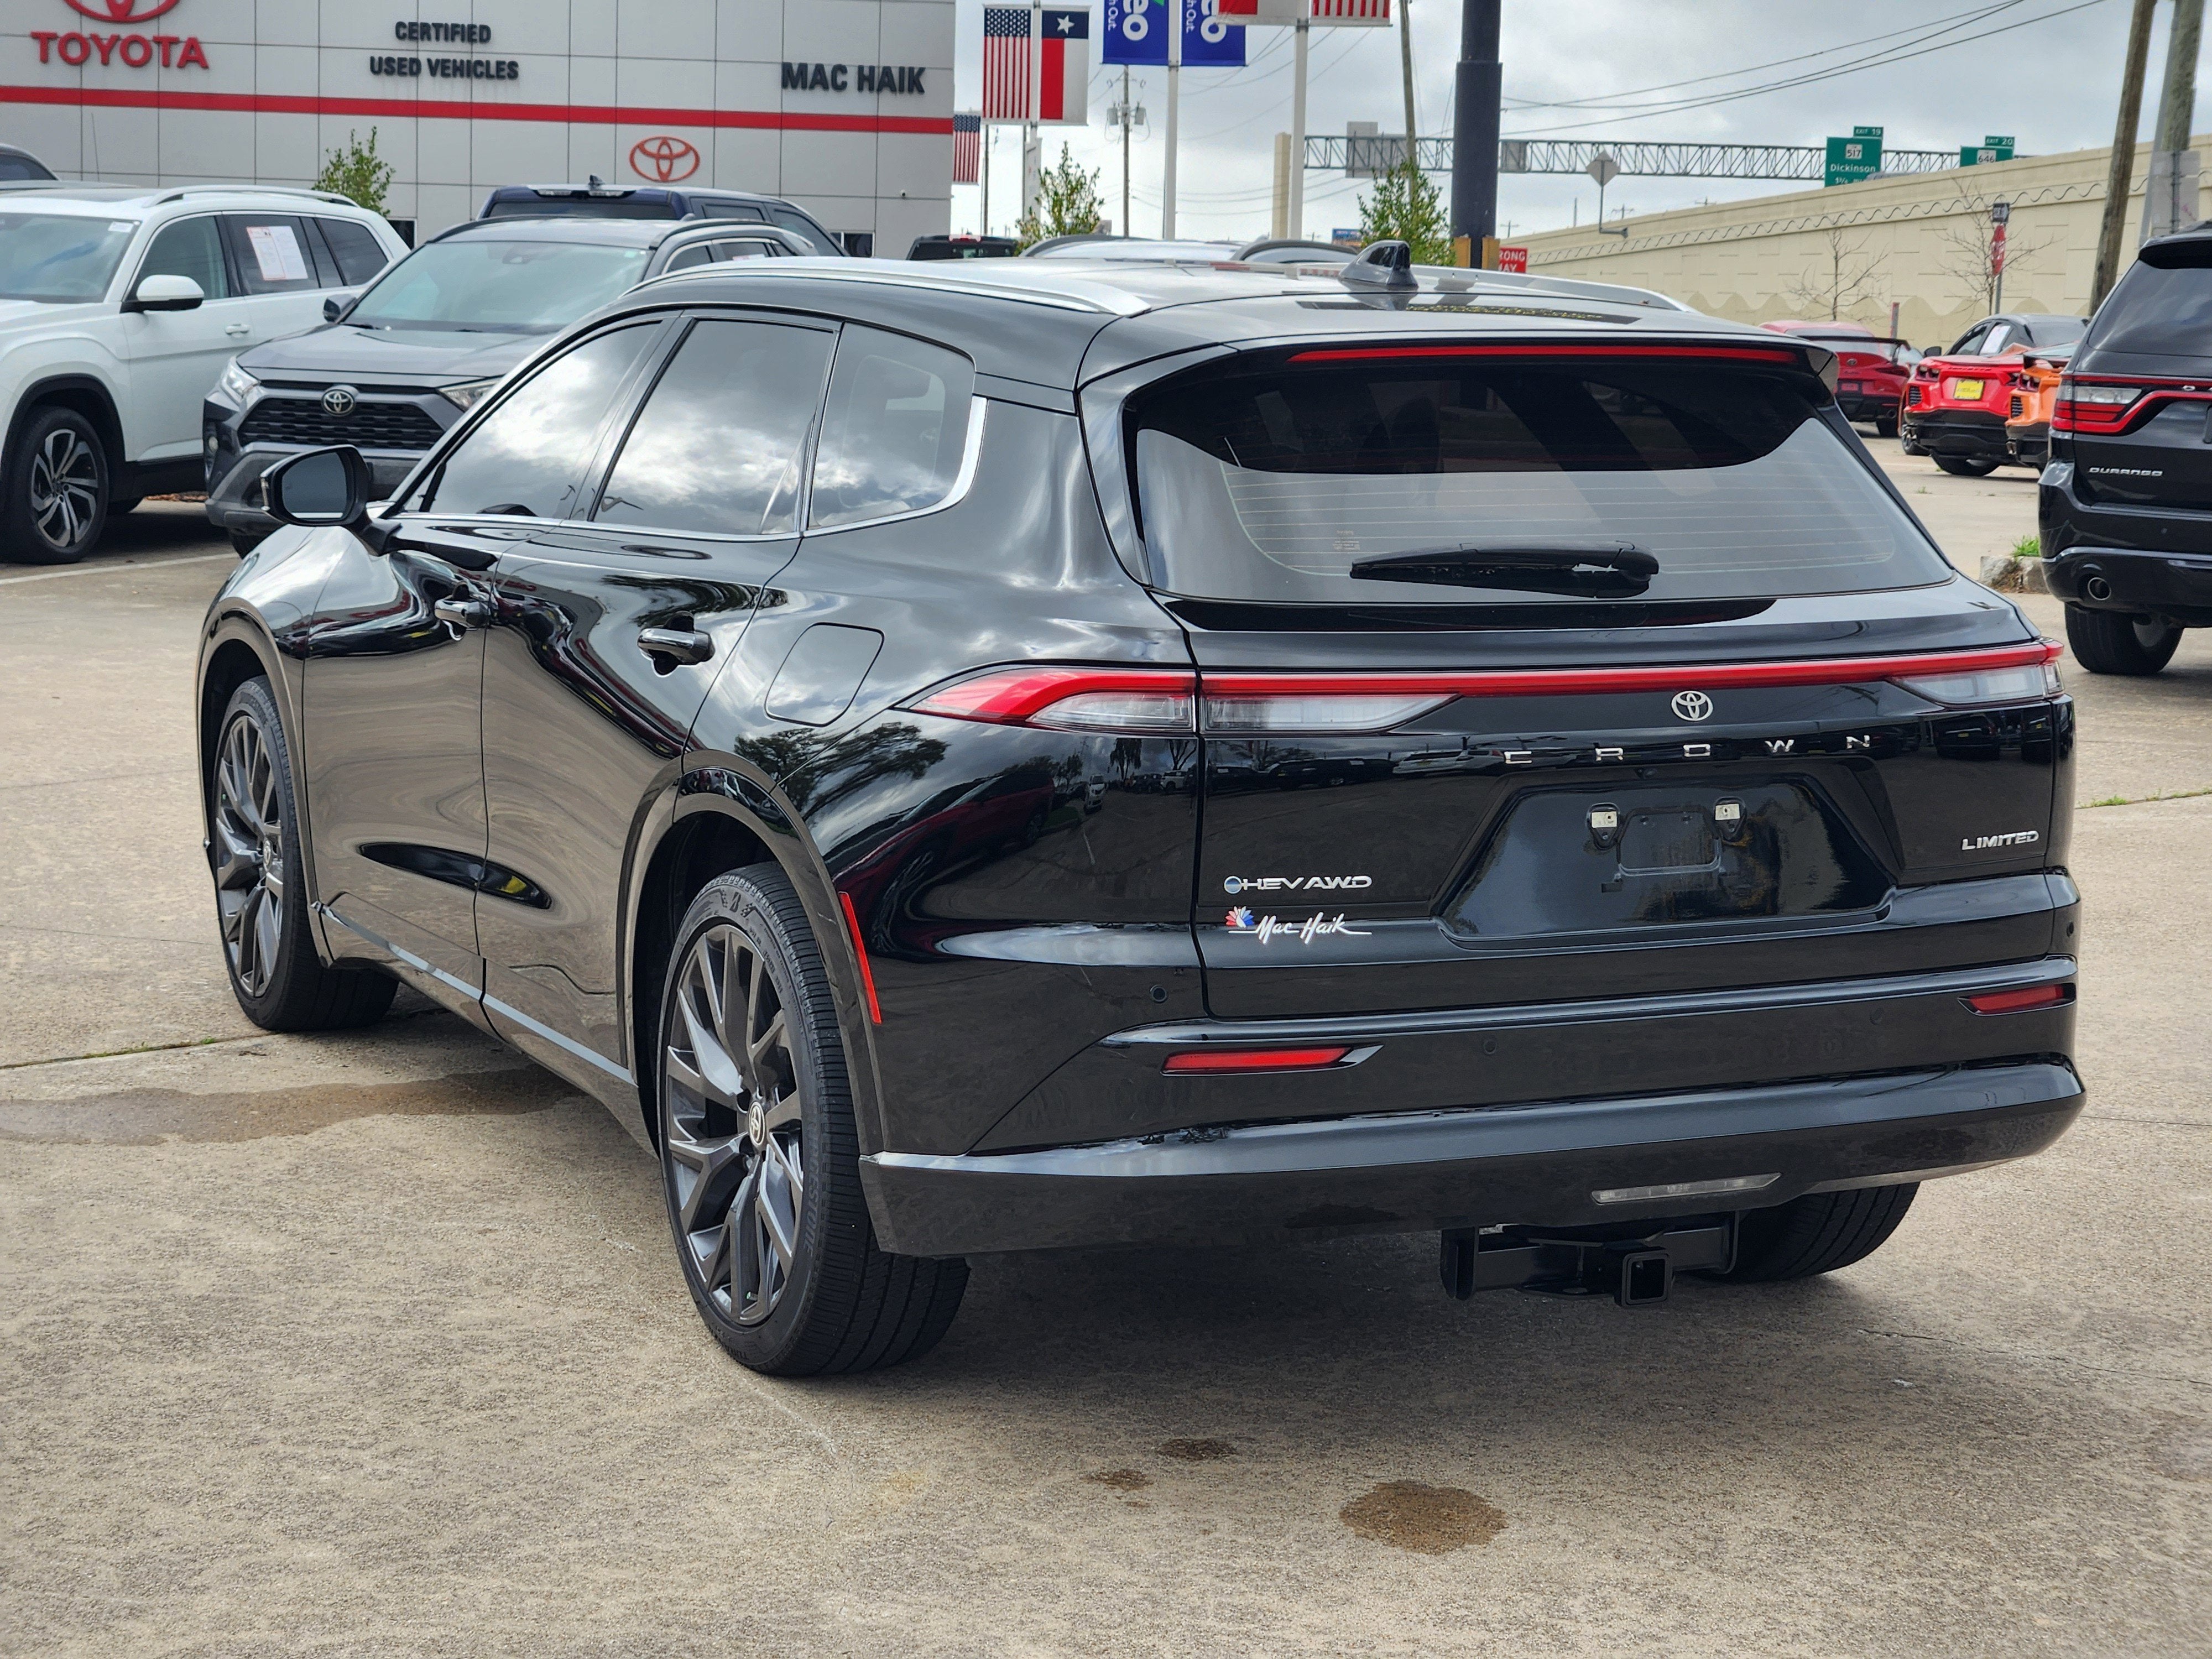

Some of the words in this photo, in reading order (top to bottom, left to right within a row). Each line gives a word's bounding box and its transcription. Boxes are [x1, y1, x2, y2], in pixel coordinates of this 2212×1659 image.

[1108, 7, 1118, 32] Out
[1186, 9, 1196, 34] Out
[395, 21, 492, 44] CERTIFIED
[30, 31, 210, 69] TOYOTA
[369, 56, 422, 77] USED
[426, 57, 519, 80] VEHICLES
[781, 62, 848, 92] MAC
[857, 65, 926, 95] HAIK
[1847, 149, 1861, 158] 517
[1978, 155, 1995, 163] 646
[1830, 163, 1876, 173] Dickinson
[1499, 250, 1526, 262] RONG
[2089, 467, 2163, 477] DURANGO
[1504, 734, 1871, 764] CROWN
[1961, 830, 2039, 851] LIMITED
[1243, 877, 1304, 890] HEV
[1303, 875, 1373, 890] AWD
[1252, 915, 1300, 945] Mac
[1300, 911, 1353, 945] Haik
